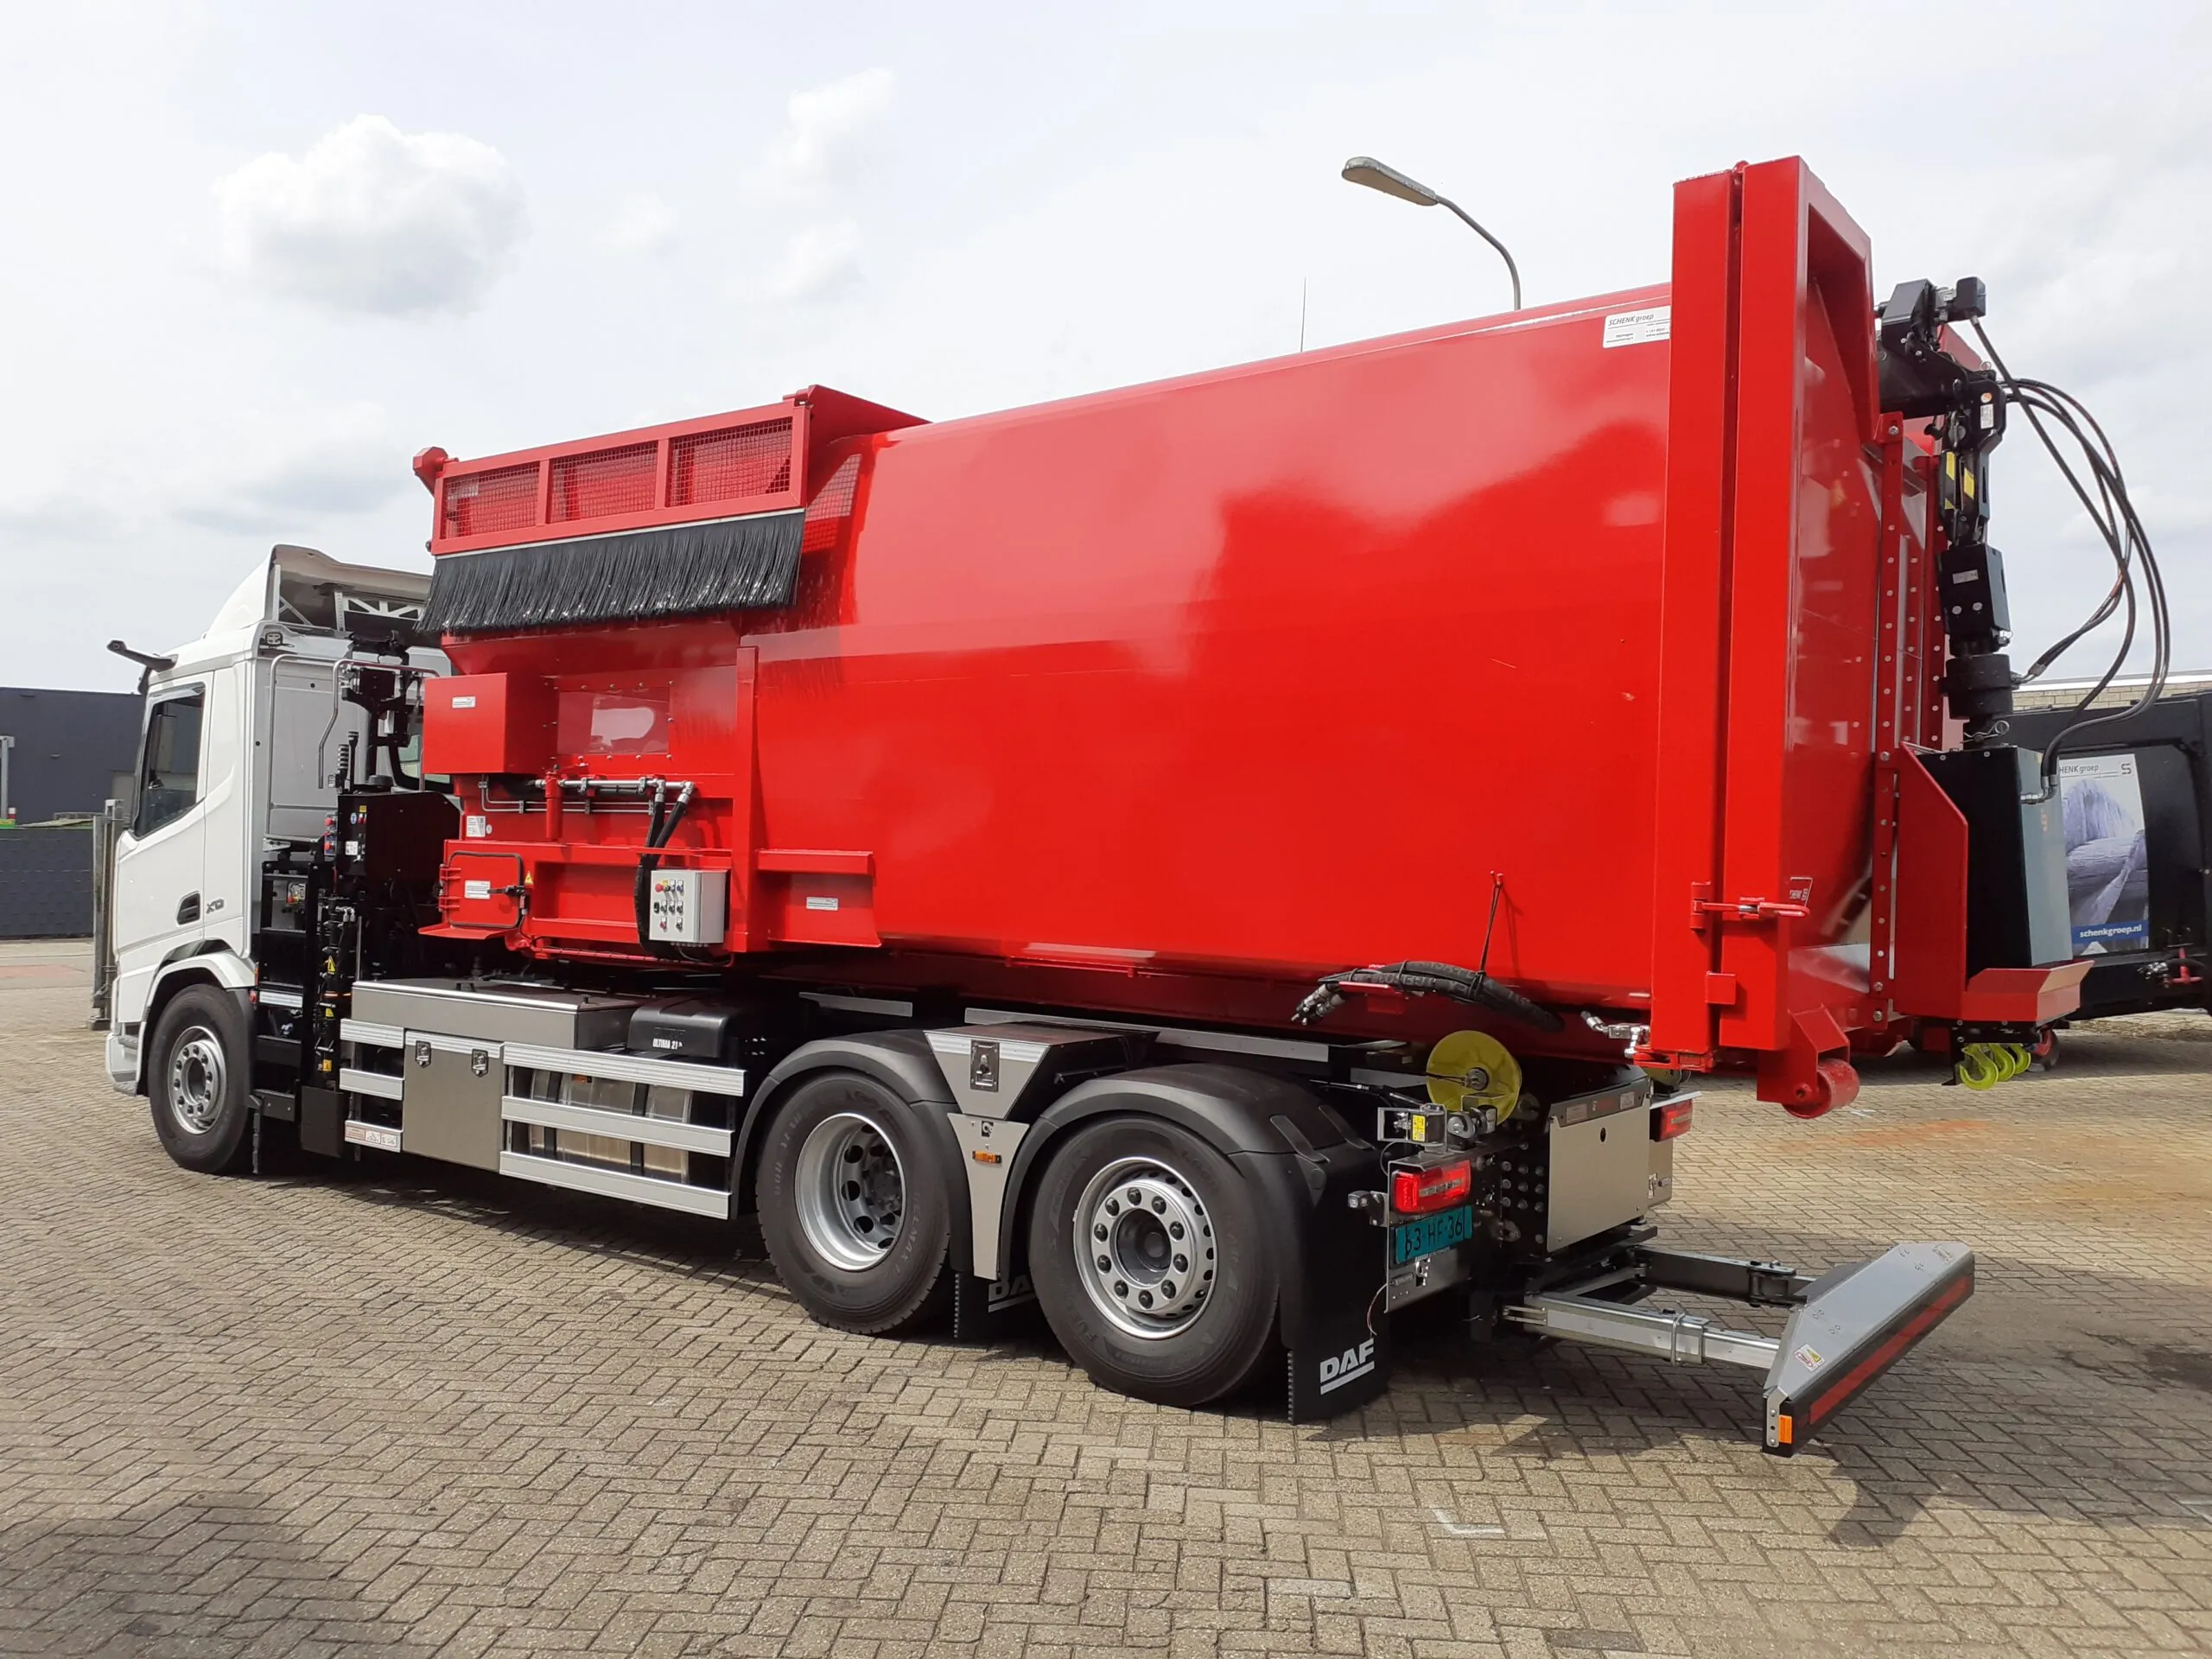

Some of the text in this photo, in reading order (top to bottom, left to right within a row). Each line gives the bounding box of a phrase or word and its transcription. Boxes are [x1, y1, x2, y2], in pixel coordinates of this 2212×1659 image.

[1608, 316, 1635, 327] SCHENK
[2059, 764, 2100, 775] HENK groep
[2080, 924, 2142, 938] schenkgroep.nl
[988, 1274, 1032, 1302] DA
[1319, 1338, 1374, 1383] DAF
